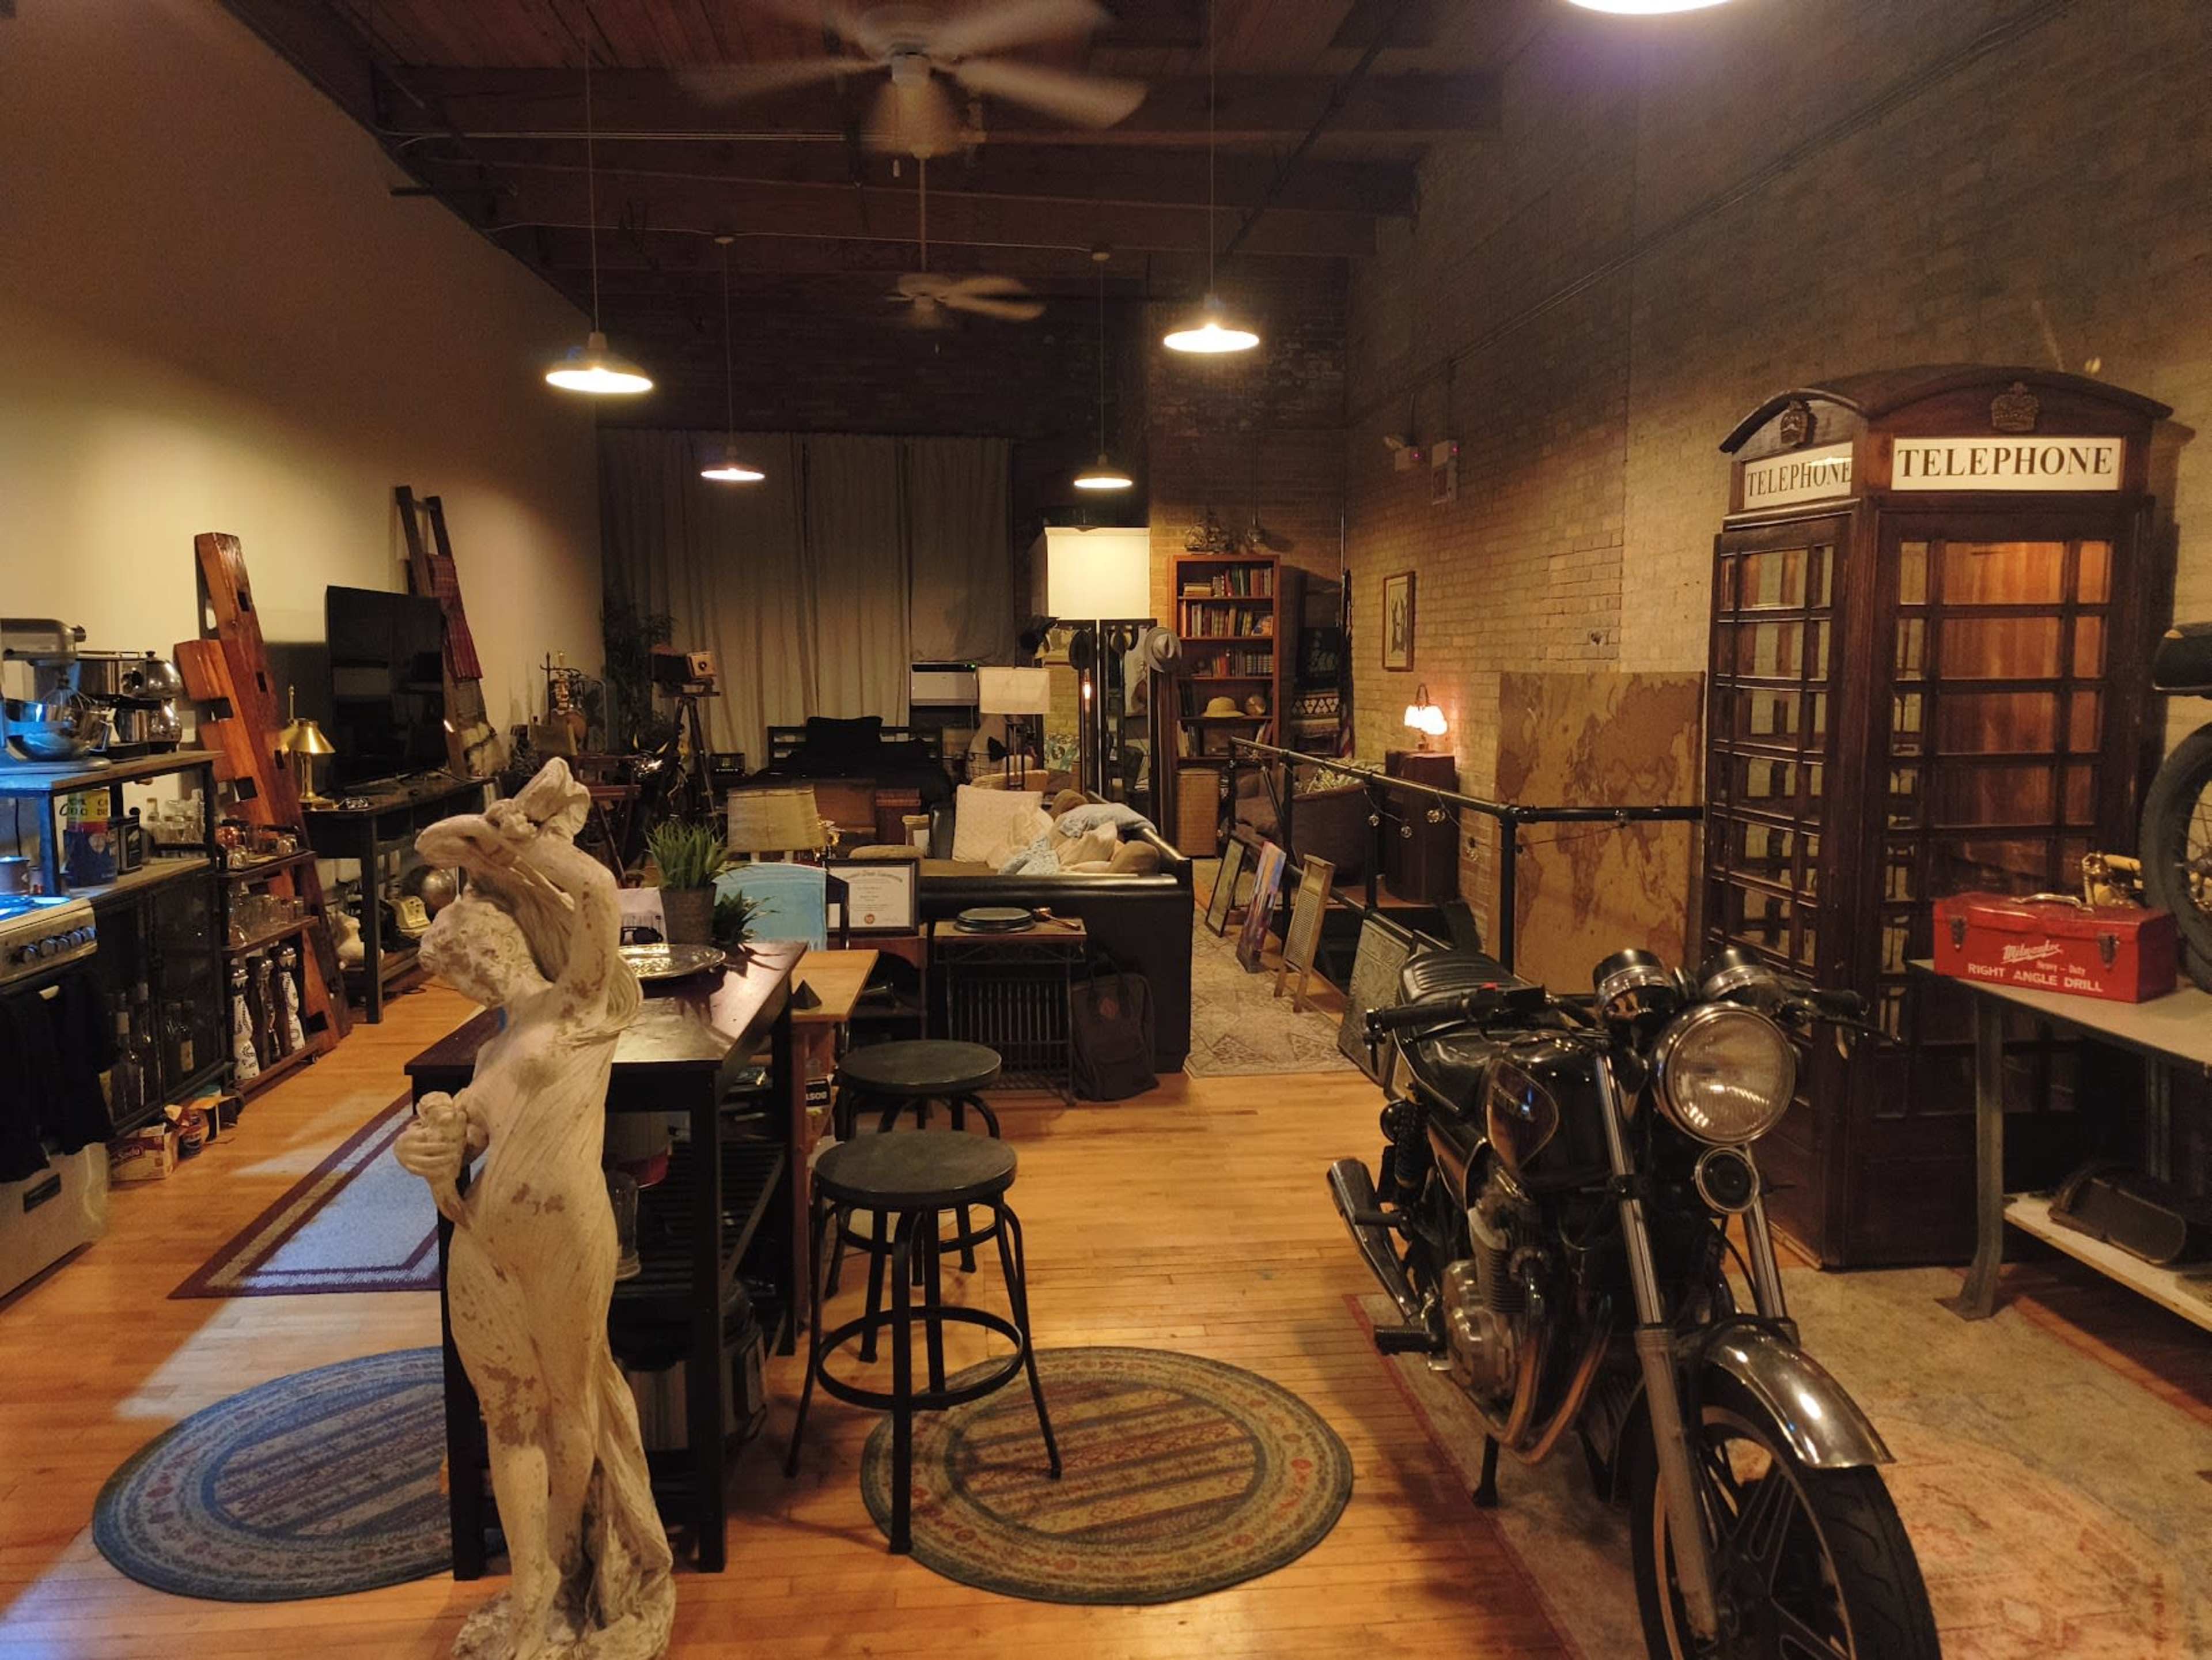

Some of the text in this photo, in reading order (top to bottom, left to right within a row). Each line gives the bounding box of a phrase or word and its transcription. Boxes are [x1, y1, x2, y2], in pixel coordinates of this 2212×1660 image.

[1897, 447, 2113, 477] TELEPHONE
[1747, 462, 1851, 496] TELEPHONE
[1968, 963, 2103, 992] RIGHT ANGLE DRILL
